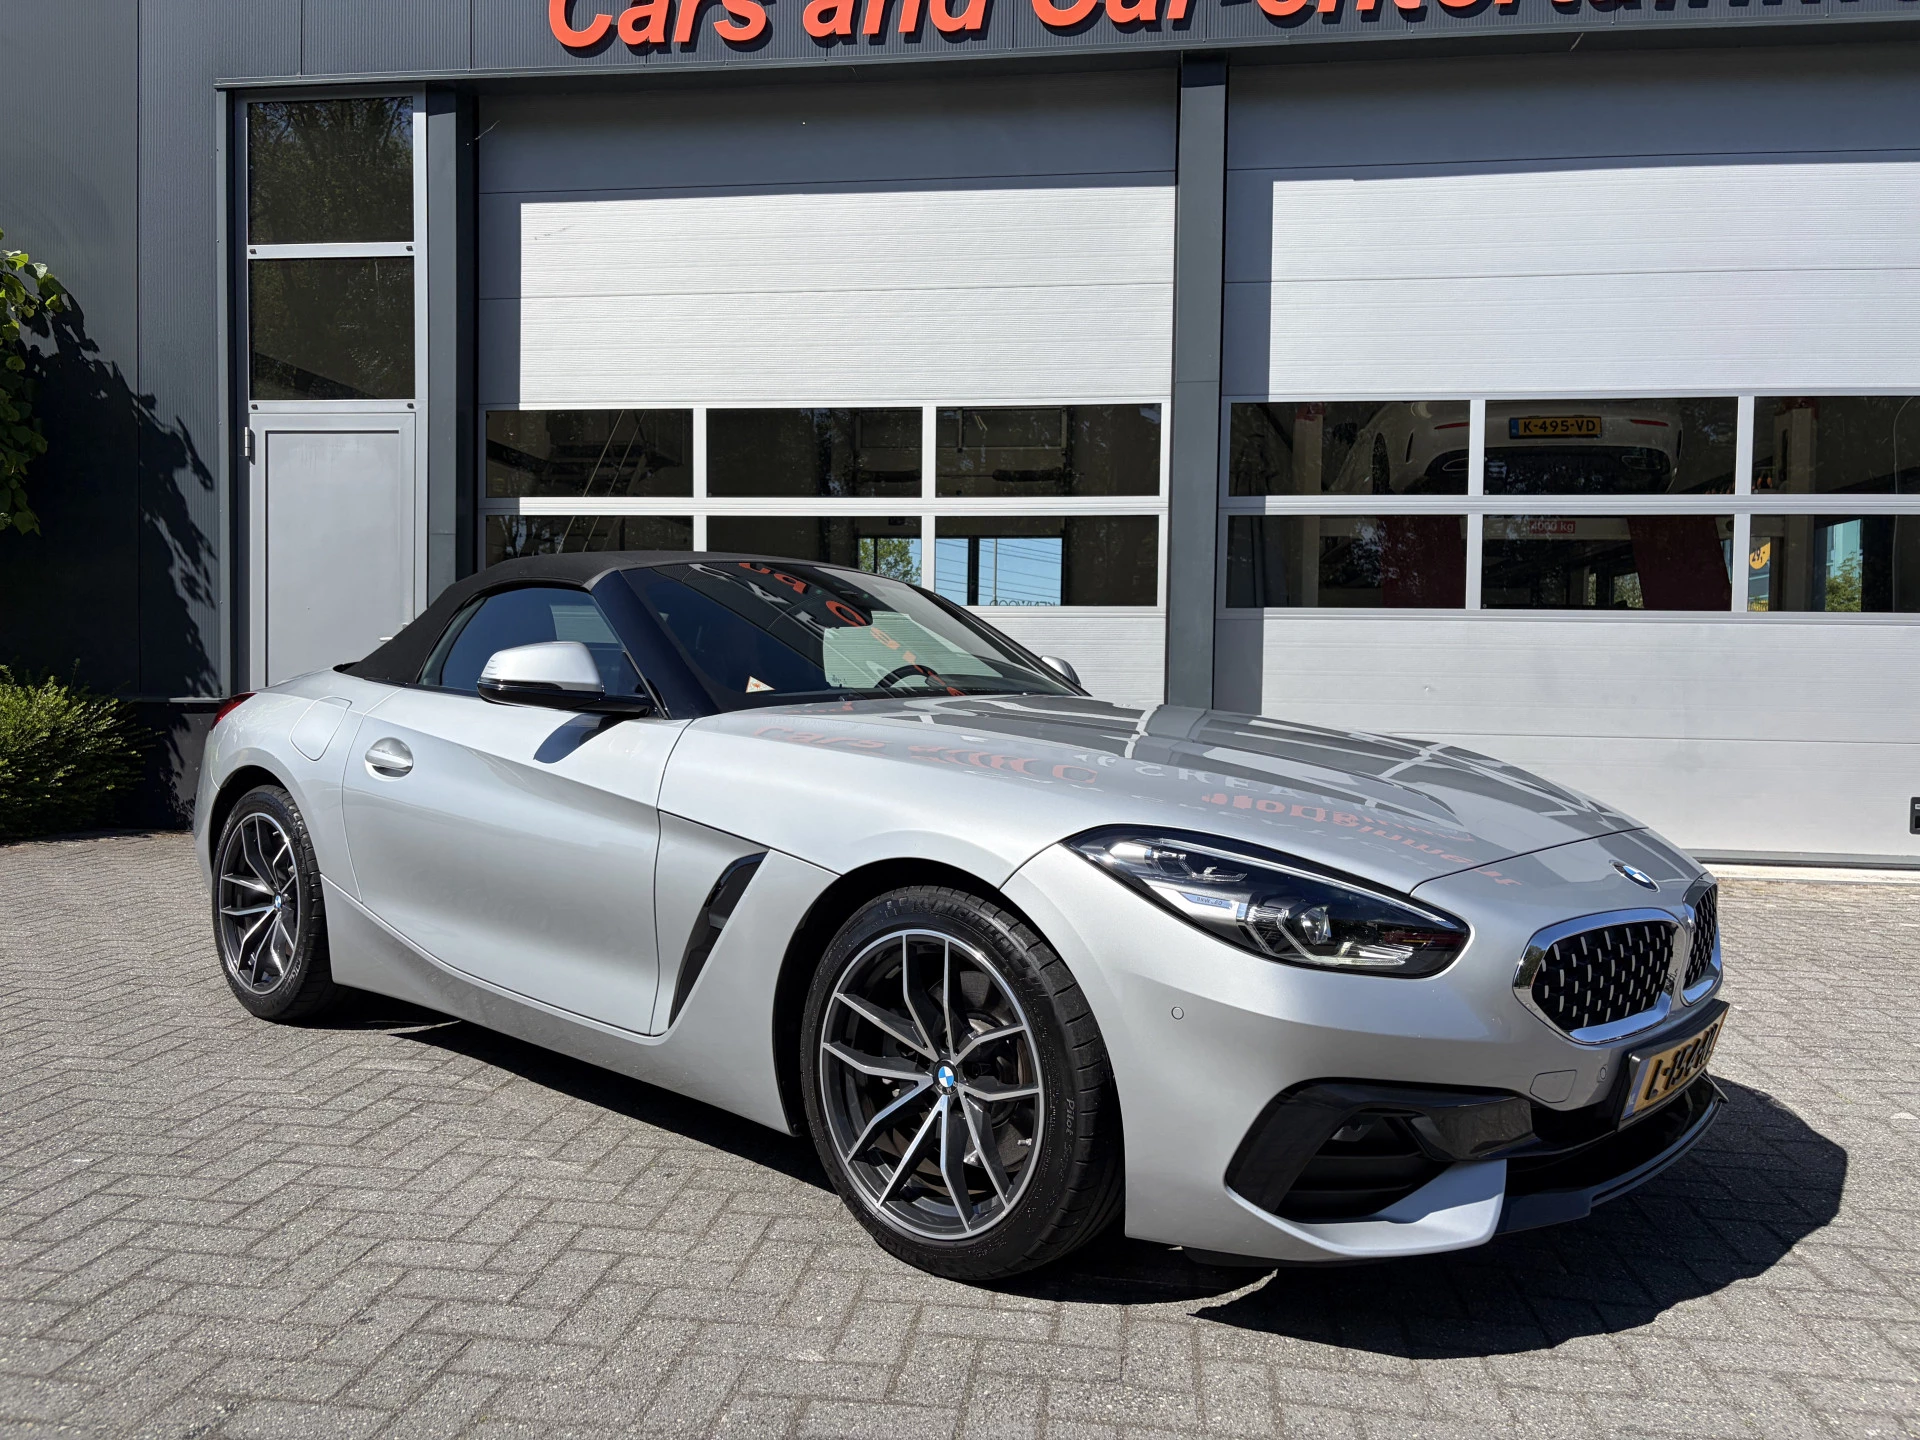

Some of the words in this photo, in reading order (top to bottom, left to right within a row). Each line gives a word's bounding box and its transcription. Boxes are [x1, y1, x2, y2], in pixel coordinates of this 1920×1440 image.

[548, 0, 767, 48] Cars
[1522, 420, 1597, 434] K-495-VD
[1530, 521, 1558, 532] 4000
[1560, 521, 1575, 533] kg
